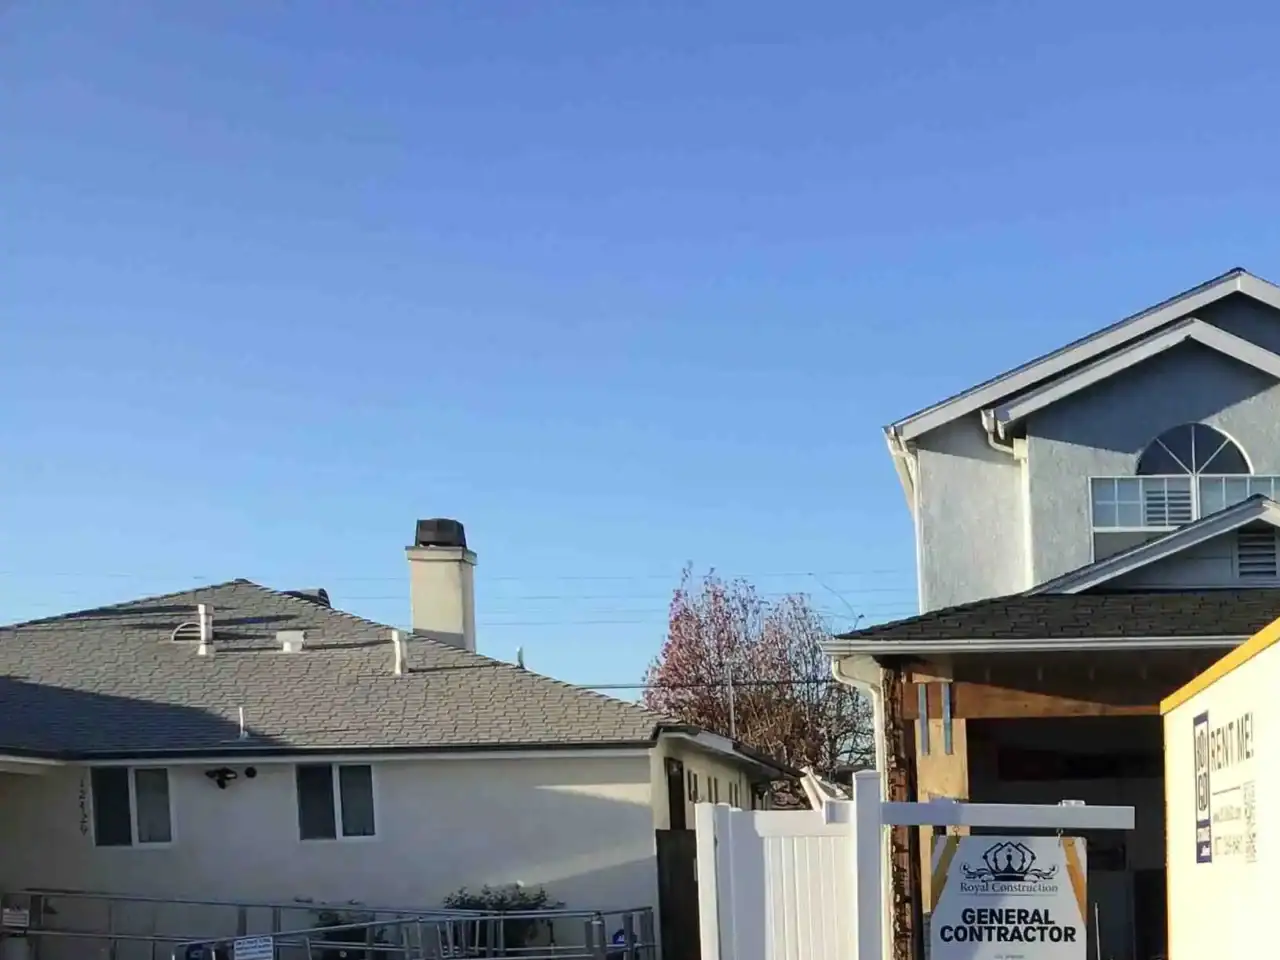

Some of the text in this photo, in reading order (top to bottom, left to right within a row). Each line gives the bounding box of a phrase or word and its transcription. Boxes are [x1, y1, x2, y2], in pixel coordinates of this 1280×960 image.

[1210, 721, 1234, 773] RENT
[1237, 710, 1255, 764] ME!
[960, 881, 1059, 894] Royal Construction
[961, 908, 1055, 925] GENERAL
[940, 925, 1077, 943] CONTRACTOR
